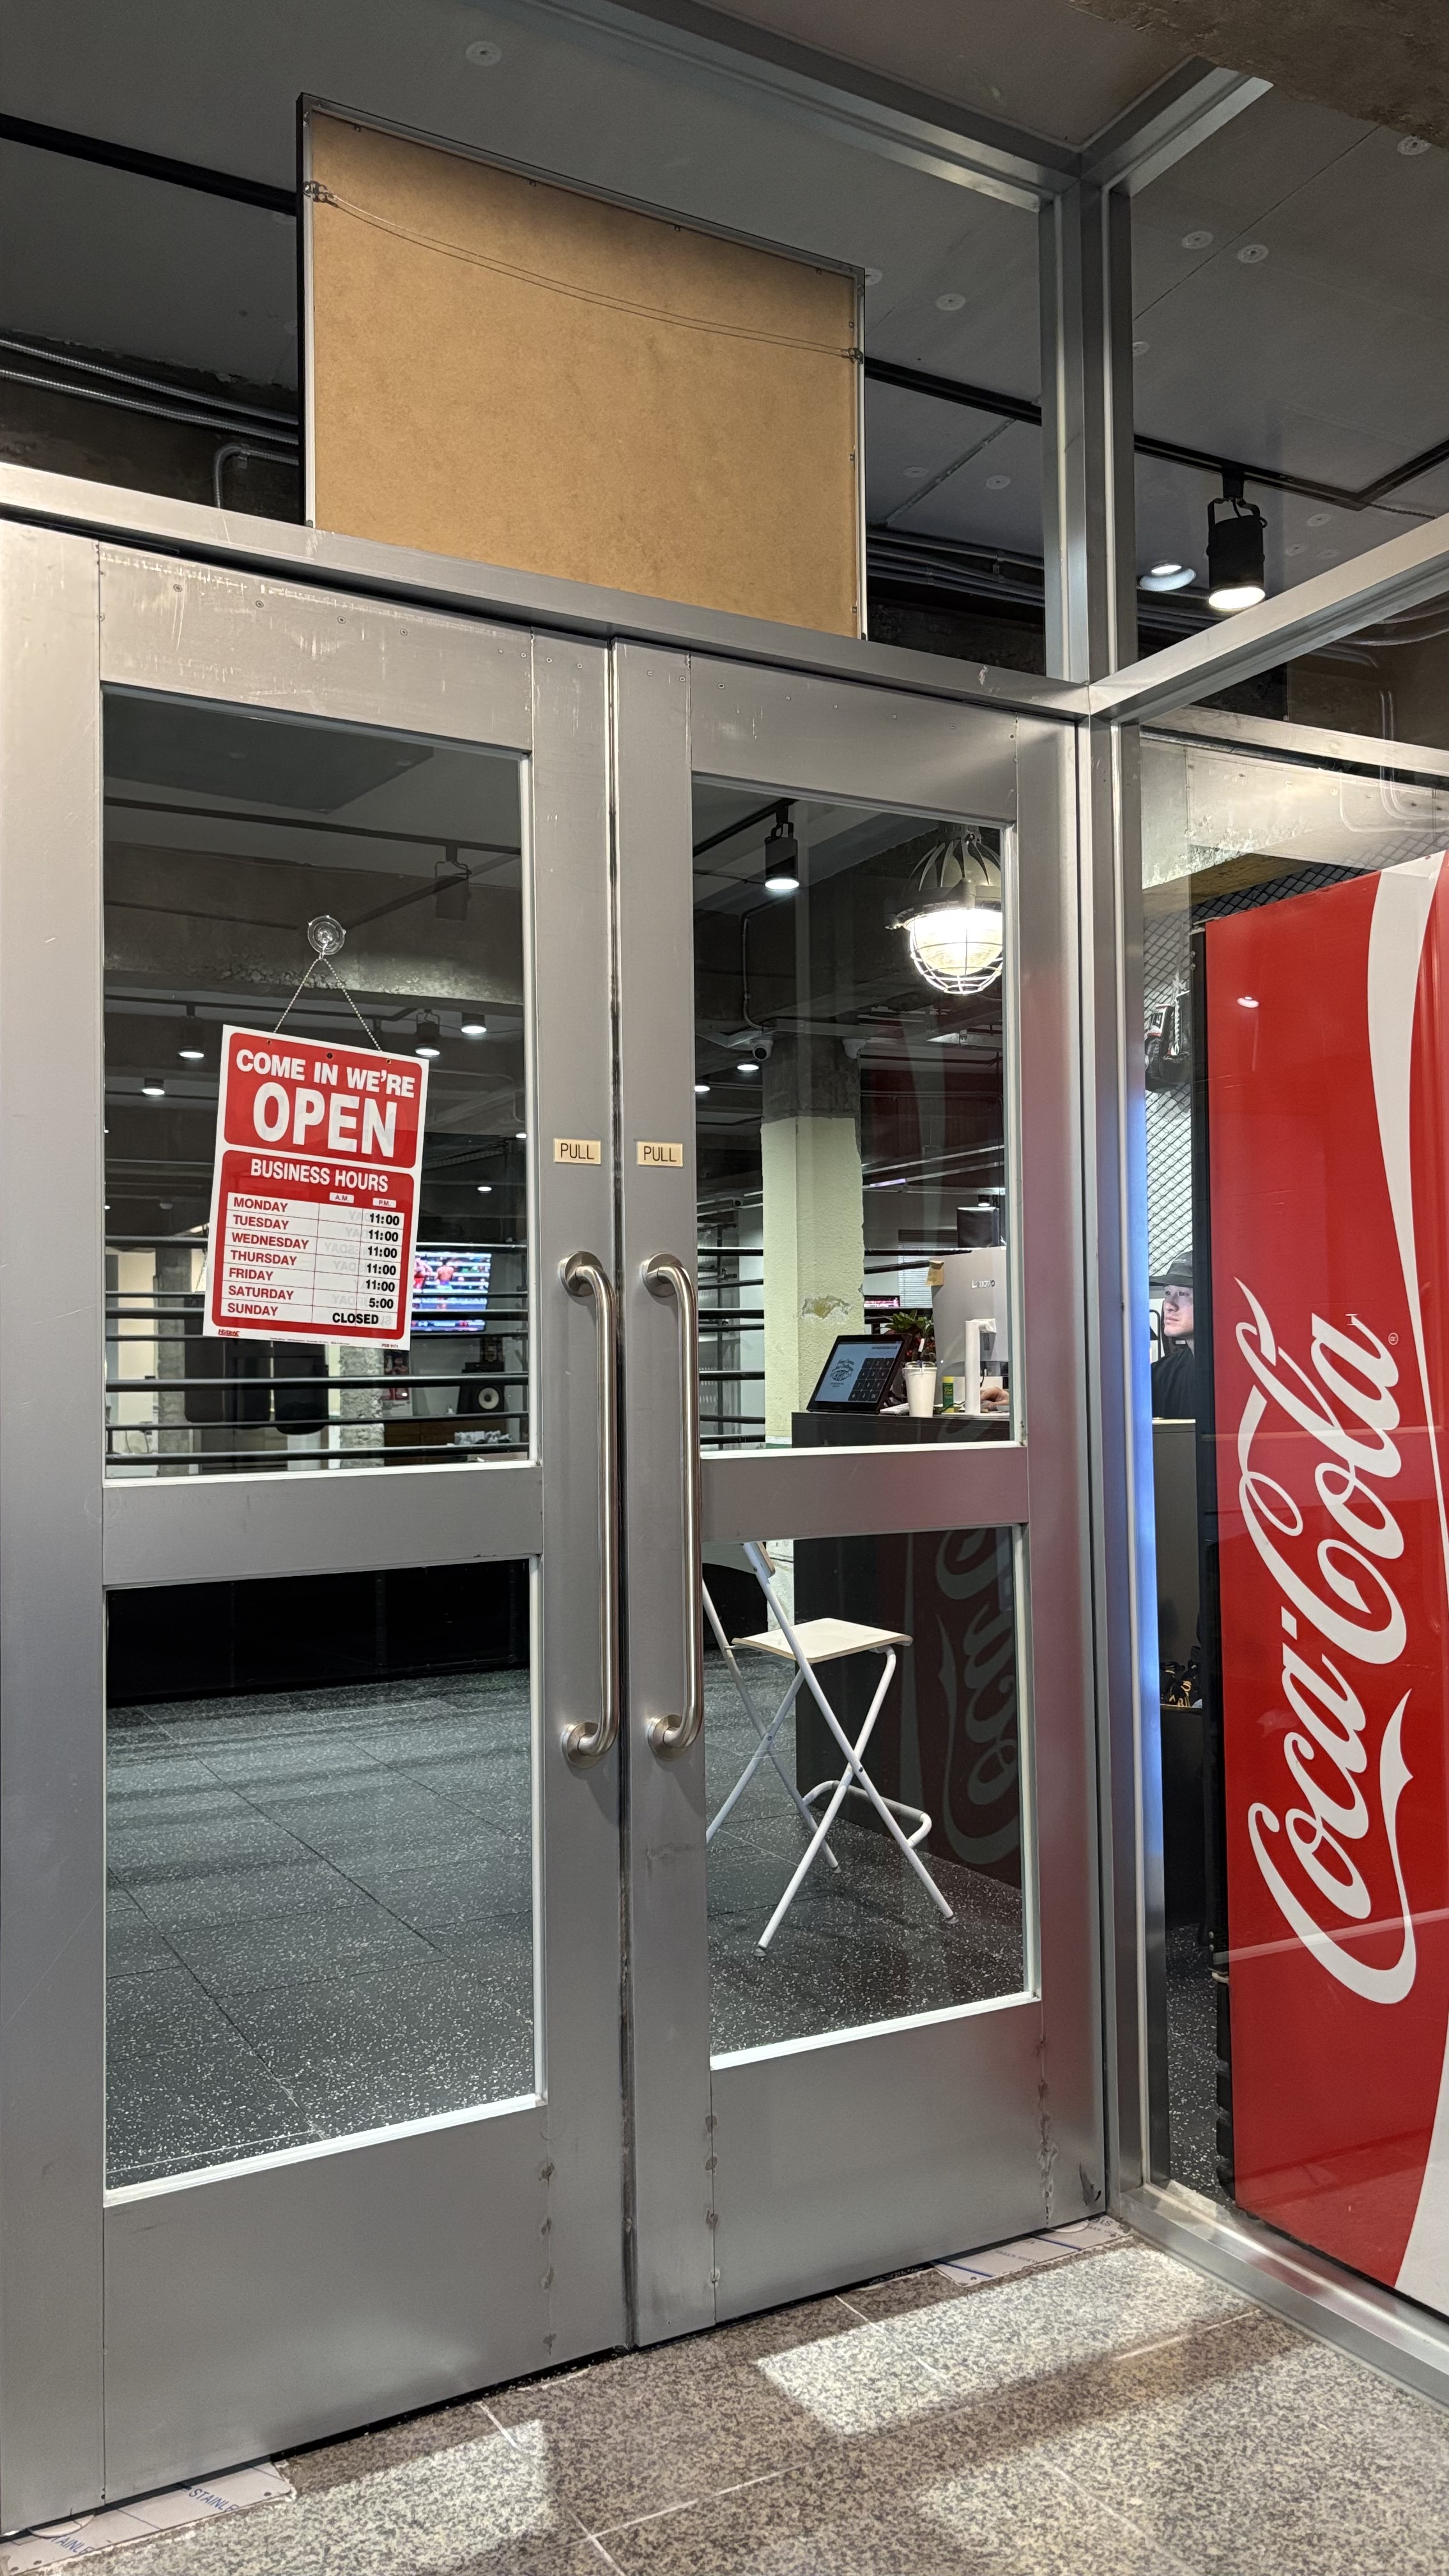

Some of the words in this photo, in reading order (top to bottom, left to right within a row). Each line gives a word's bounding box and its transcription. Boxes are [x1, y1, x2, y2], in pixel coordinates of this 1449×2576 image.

[236, 1049, 306, 1081] COME
[314, 1062, 339, 1086] IN
[347, 1067, 415, 1098] WE'RE
[253, 1082, 397, 1158] OPEN
[560, 1142, 595, 1160] PULL
[643, 1146, 677, 1163] PULL
[250, 1158, 330, 1185] BUSINESS
[335, 1169, 388, 1193] HOURS
[233, 1197, 289, 1213] MONDAY
[369, 1213, 400, 1226] 11:00
[233, 1215, 289, 1230] TUESDAY
[369, 1229, 399, 1242] 11:00
[232, 1232, 309, 1250] WEDNESDAY
[367, 1245, 397, 1259] 11:00
[231, 1250, 297, 1266] THURSDAY
[367, 1262, 397, 1276] 11:00
[229, 1267, 274, 1281] FRIDAY
[365, 1279, 395, 1292] 11:00
[228, 1285, 295, 1300] SATURDAY
[369, 1297, 394, 1309] 5:00
[227, 1302, 279, 1317] SUNDAY
[332, 1312, 379, 1324] CLOSED
[1234, 1276, 1414, 2005] Coca-Cola
